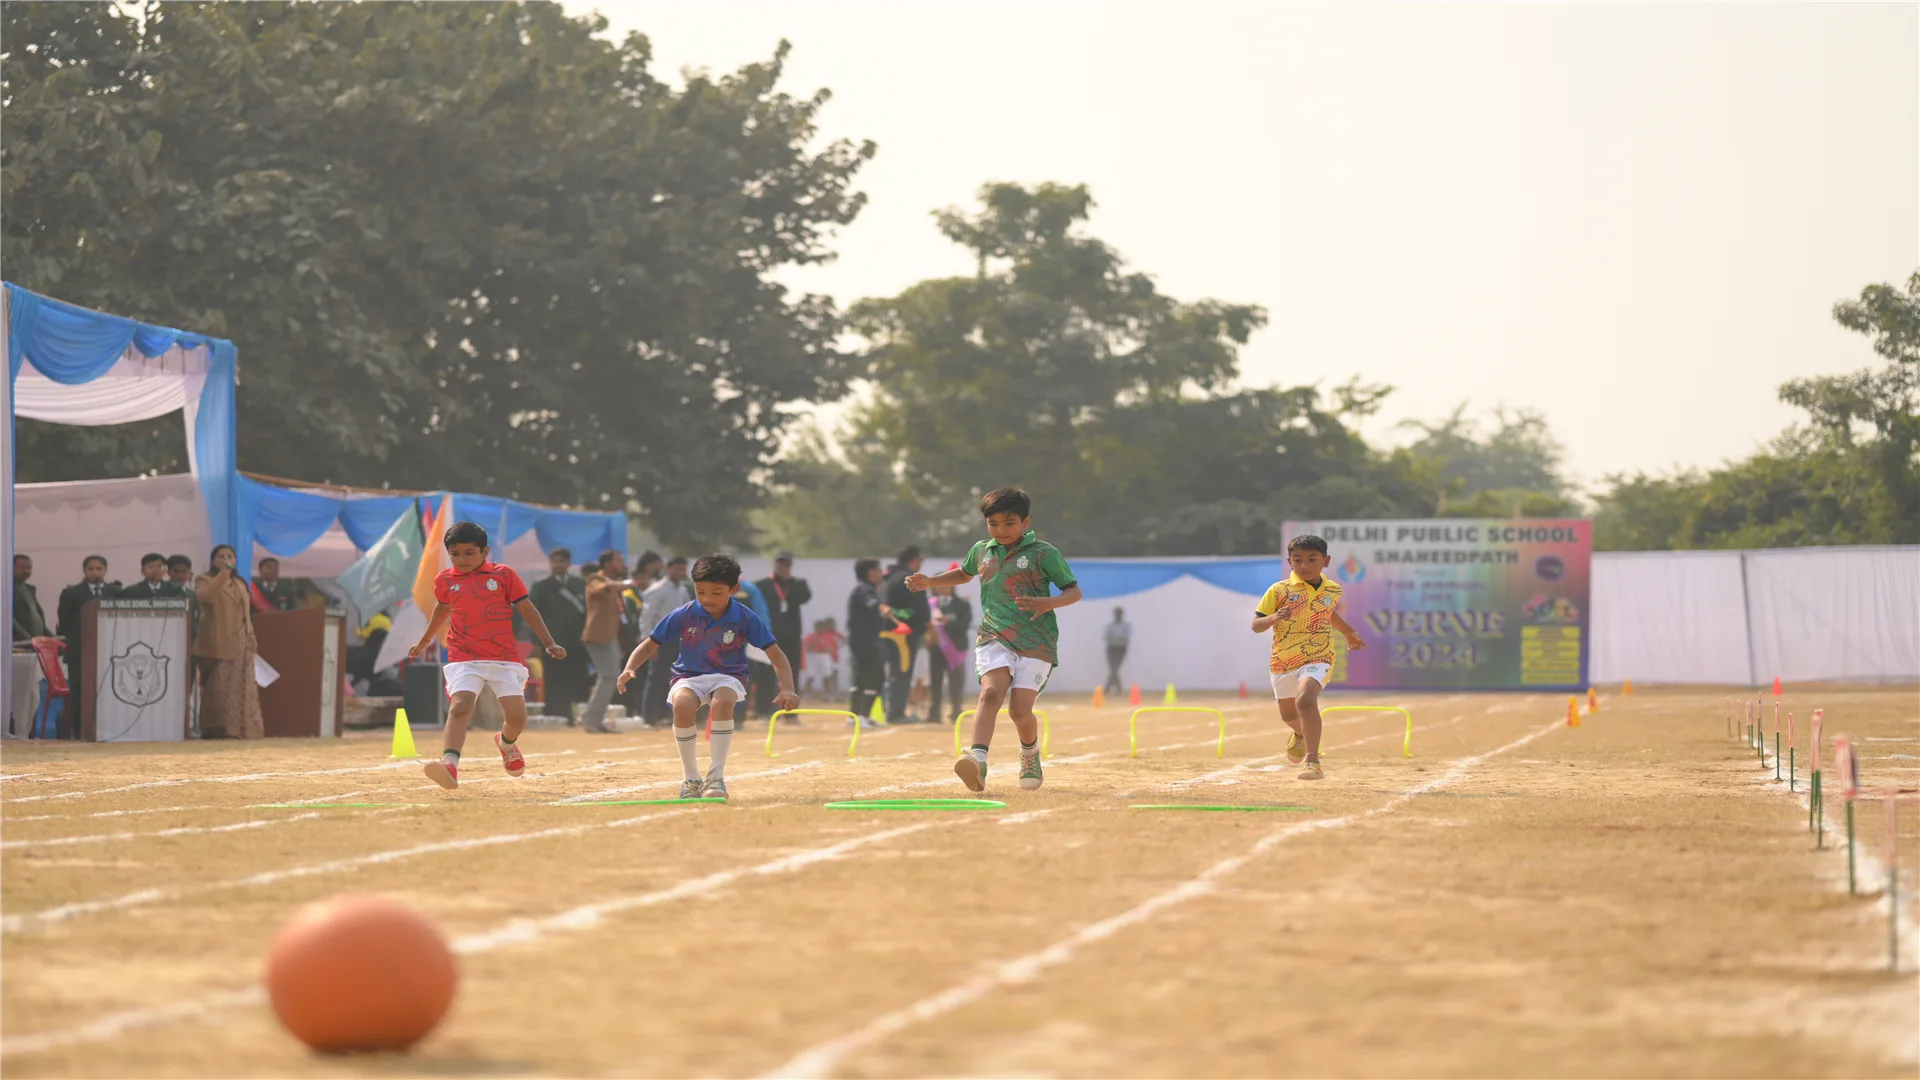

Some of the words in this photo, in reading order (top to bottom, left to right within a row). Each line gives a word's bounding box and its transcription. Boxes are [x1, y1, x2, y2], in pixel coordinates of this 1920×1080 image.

[1322, 526, 1389, 542] DELHI
[1396, 526, 1480, 542] PUBLIC
[1487, 526, 1579, 543] SCHOOL
[1373, 549, 1519, 565] SHAHEEDPATH
[1363, 608, 1506, 638] VERVE
[1389, 641, 1479, 670] 2024
